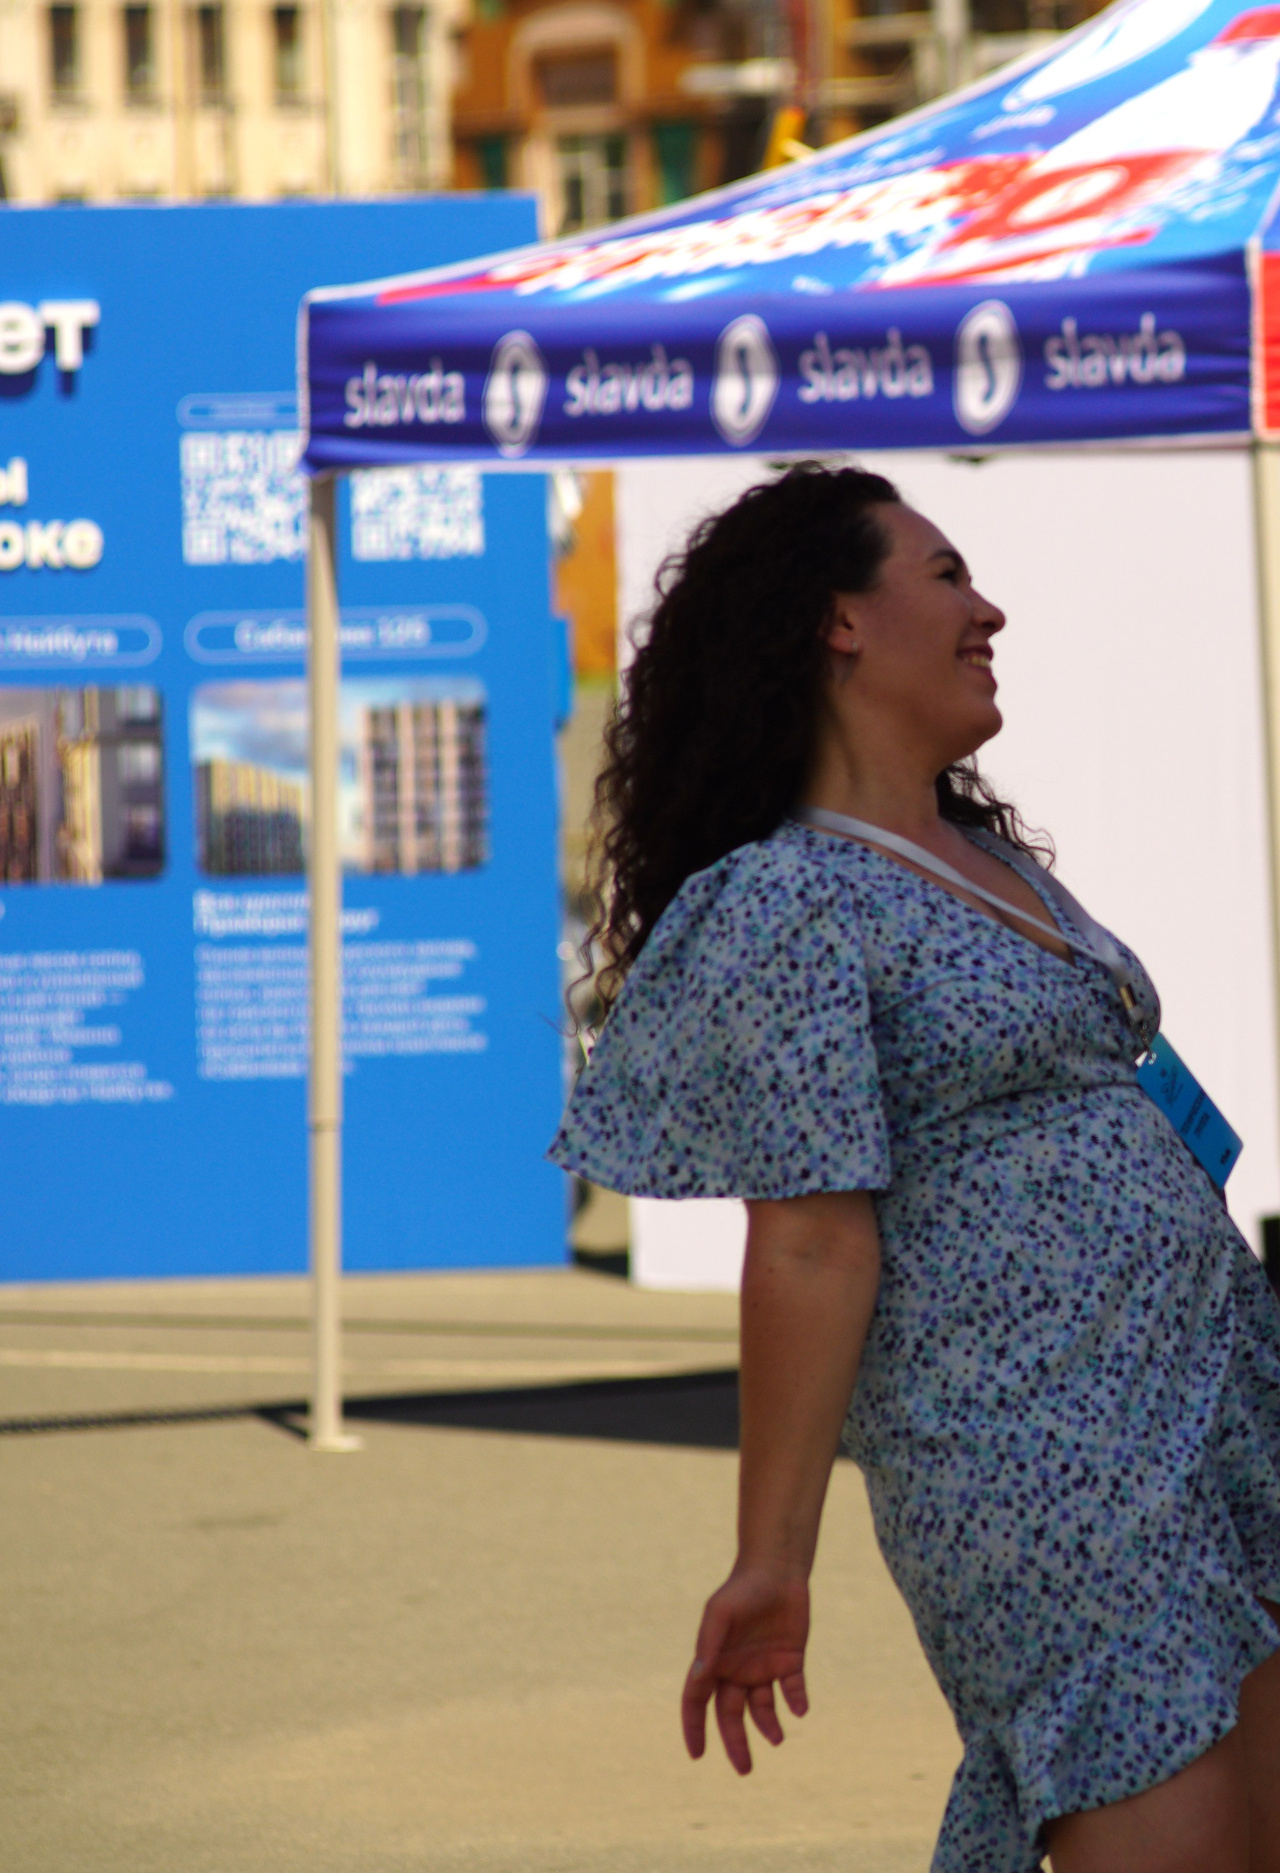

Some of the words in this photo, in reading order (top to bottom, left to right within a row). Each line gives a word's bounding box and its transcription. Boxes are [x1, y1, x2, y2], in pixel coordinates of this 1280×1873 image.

[344, 358, 465, 427] slavda
[563, 342, 694, 418] slavda
[798, 327, 934, 402] slavda
[1044, 311, 1187, 391] slavda
